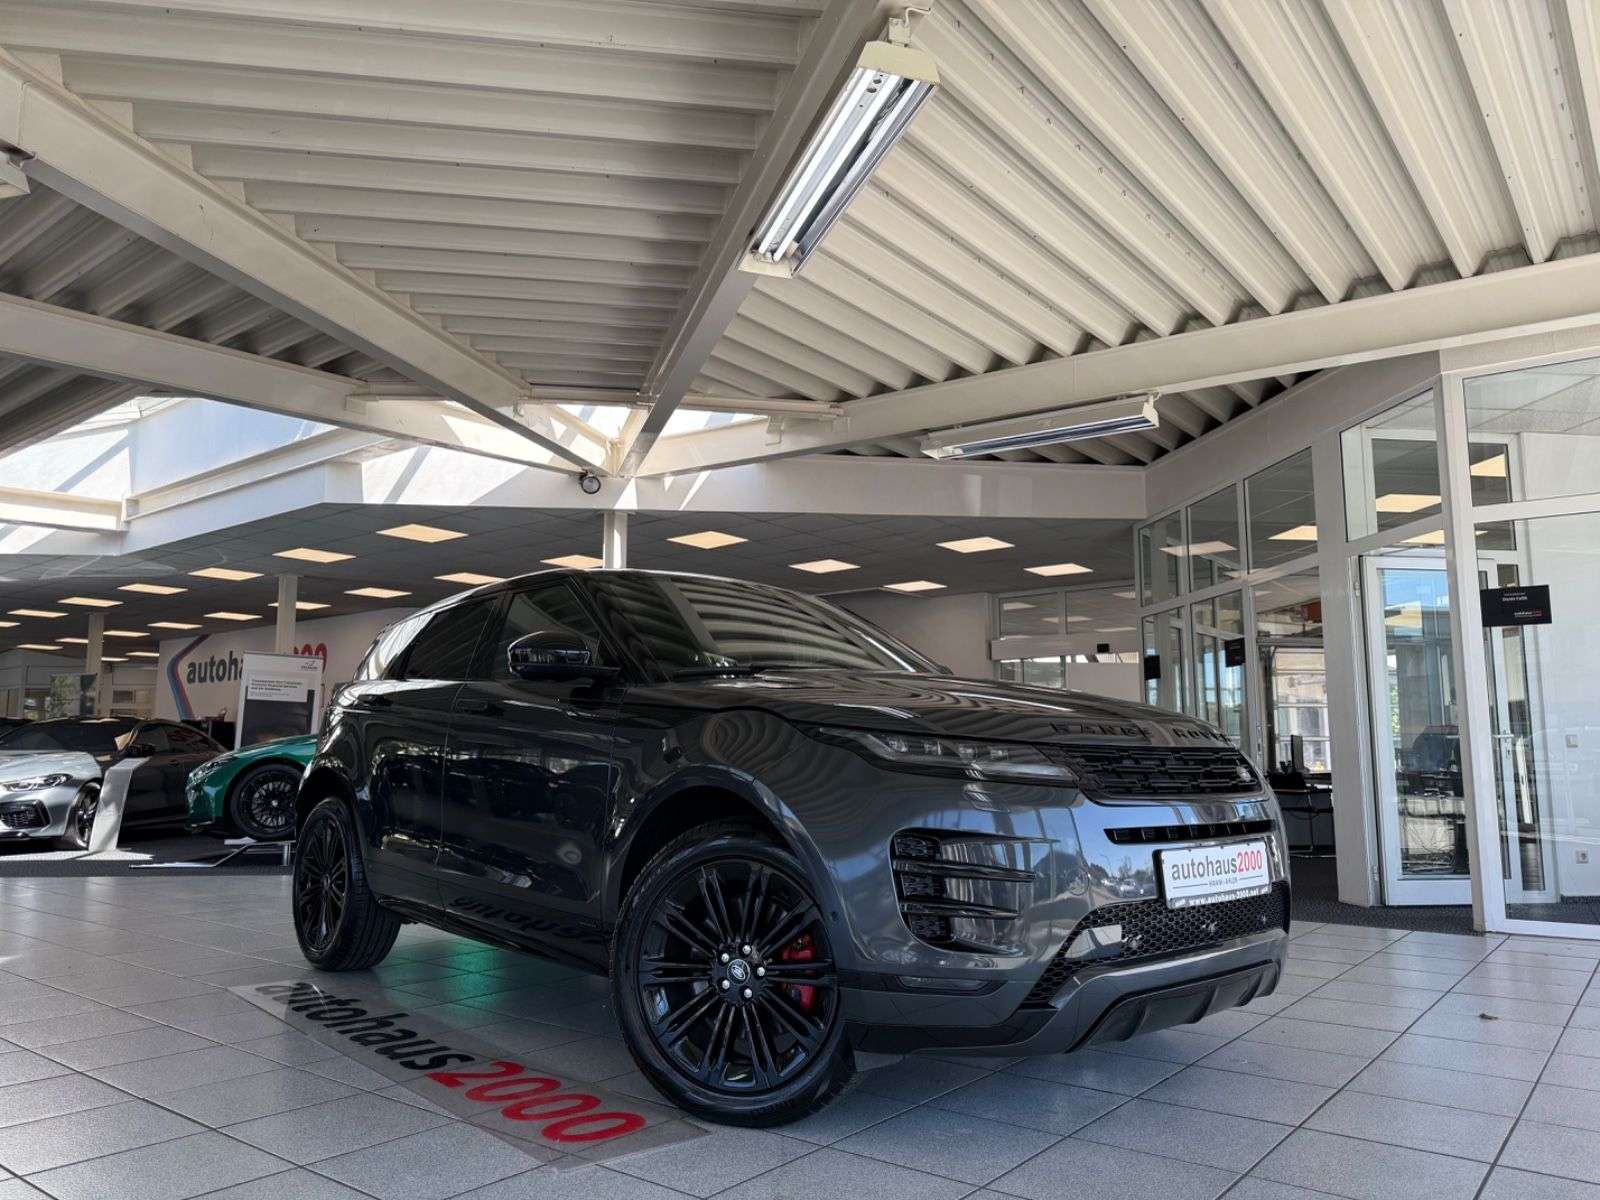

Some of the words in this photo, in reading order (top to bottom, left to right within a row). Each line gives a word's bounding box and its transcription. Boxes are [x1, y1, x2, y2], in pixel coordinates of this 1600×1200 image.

[186, 650, 243, 684] autoh
[1171, 850, 1263, 881] autohaus2000
[254, 981, 647, 1143] autohaus2000
